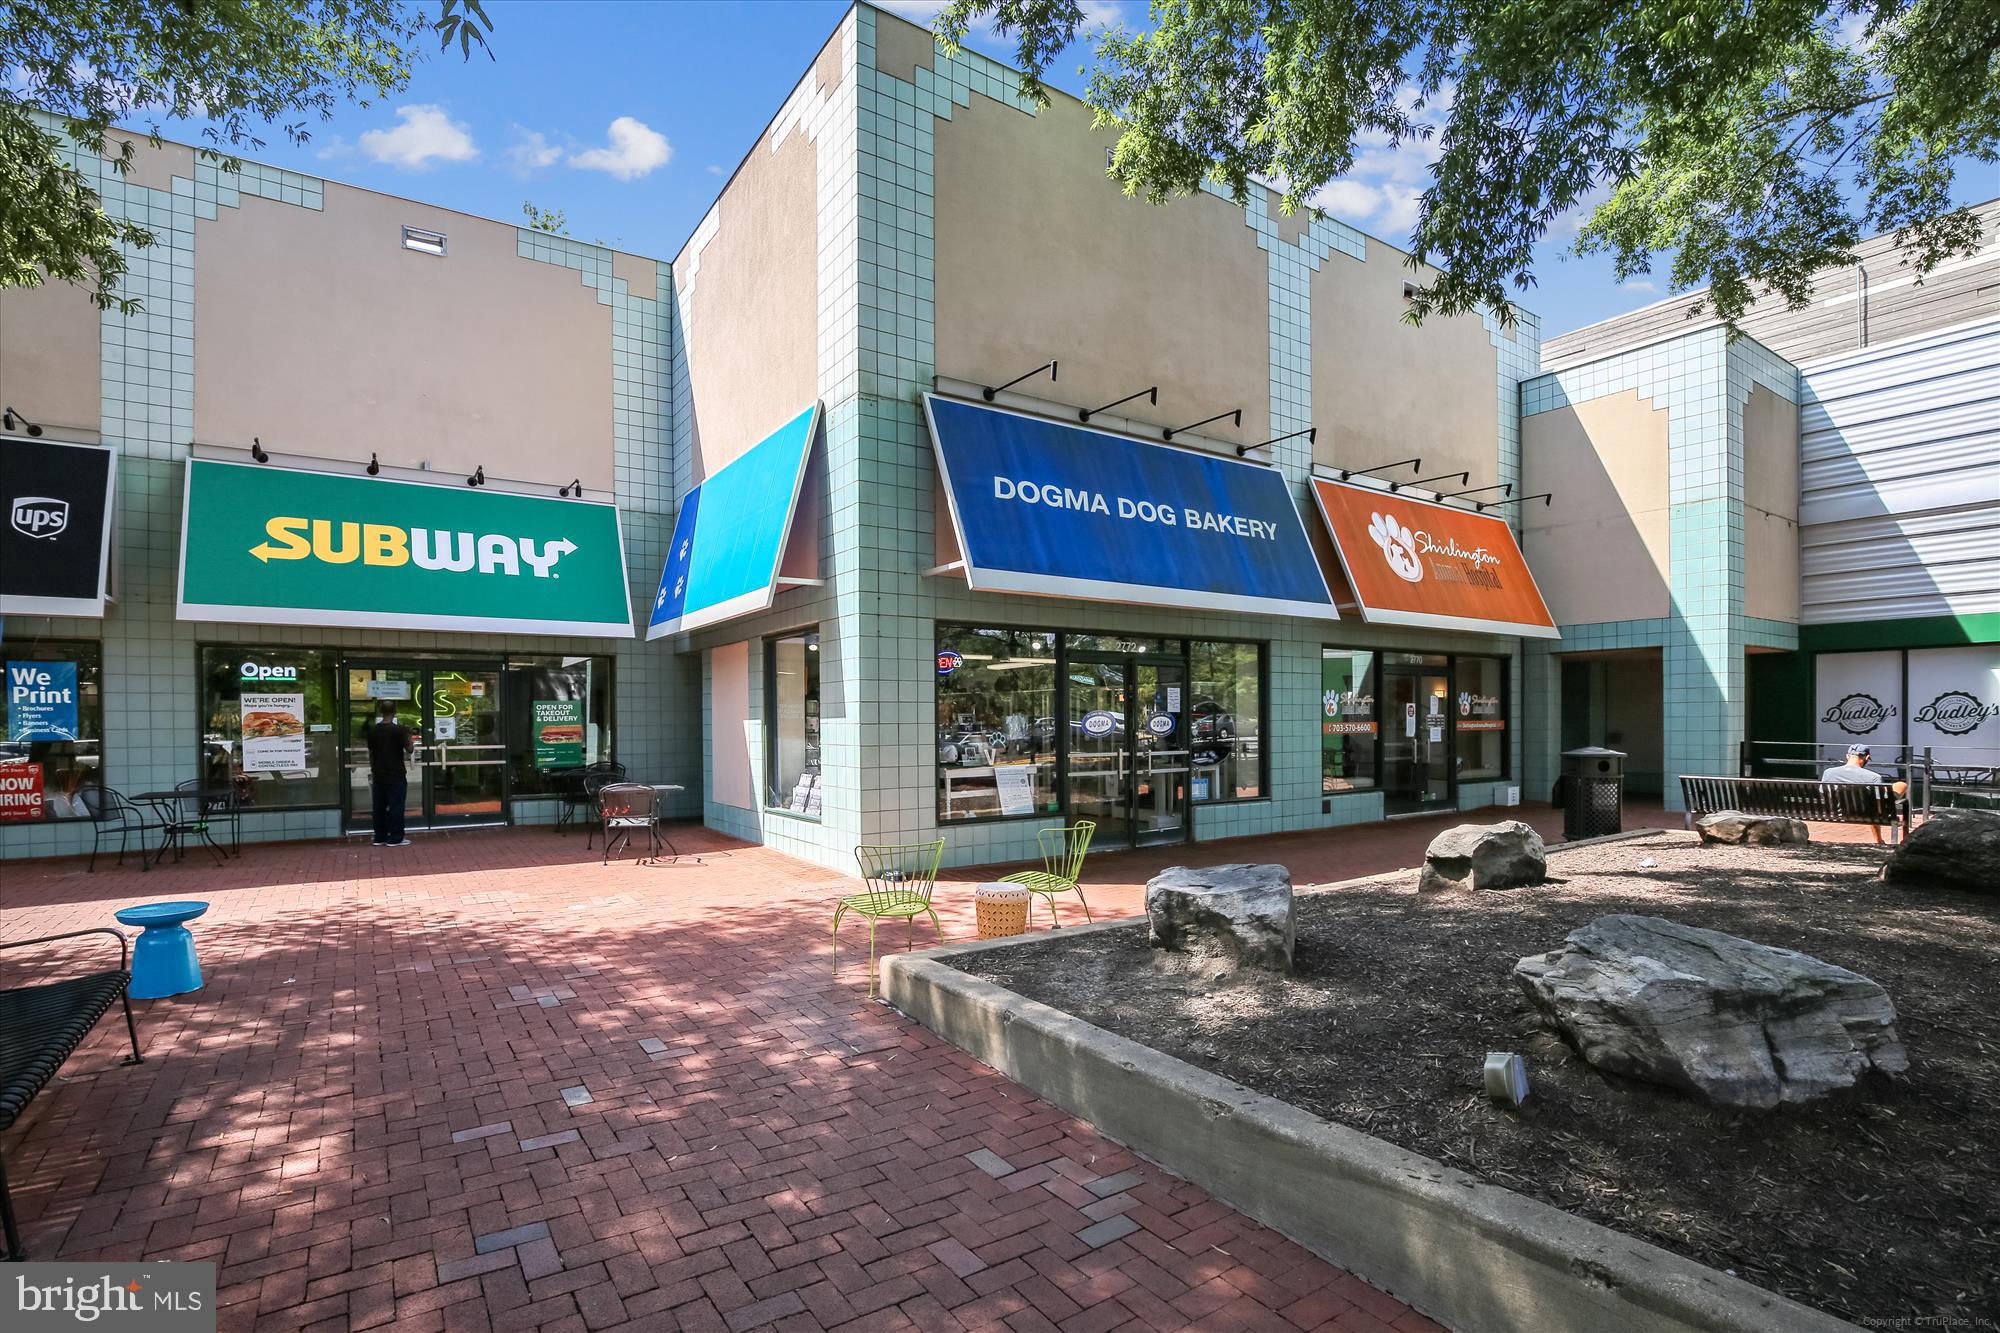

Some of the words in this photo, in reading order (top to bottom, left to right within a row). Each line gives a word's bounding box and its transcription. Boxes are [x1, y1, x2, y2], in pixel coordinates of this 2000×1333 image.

[994, 476, 1110, 516] DOGMA
[1117, 497, 1176, 526] DOG
[1184, 508, 1277, 541] BAKERY
[16, 508, 63, 531] ups
[248, 516, 578, 579] SUBWAY
[1414, 530, 1500, 569] Shirlington
[1461, 561, 1503, 591] Hospital
[11, 667, 51, 686] We
[240, 662, 297, 681] Open
[13, 686, 72, 704] Print
[1821, 705, 1897, 723] Dudley's
[1913, 703, 1999, 723] Dudley's
[1333, 724, 1371, 732] 703-570-6600
